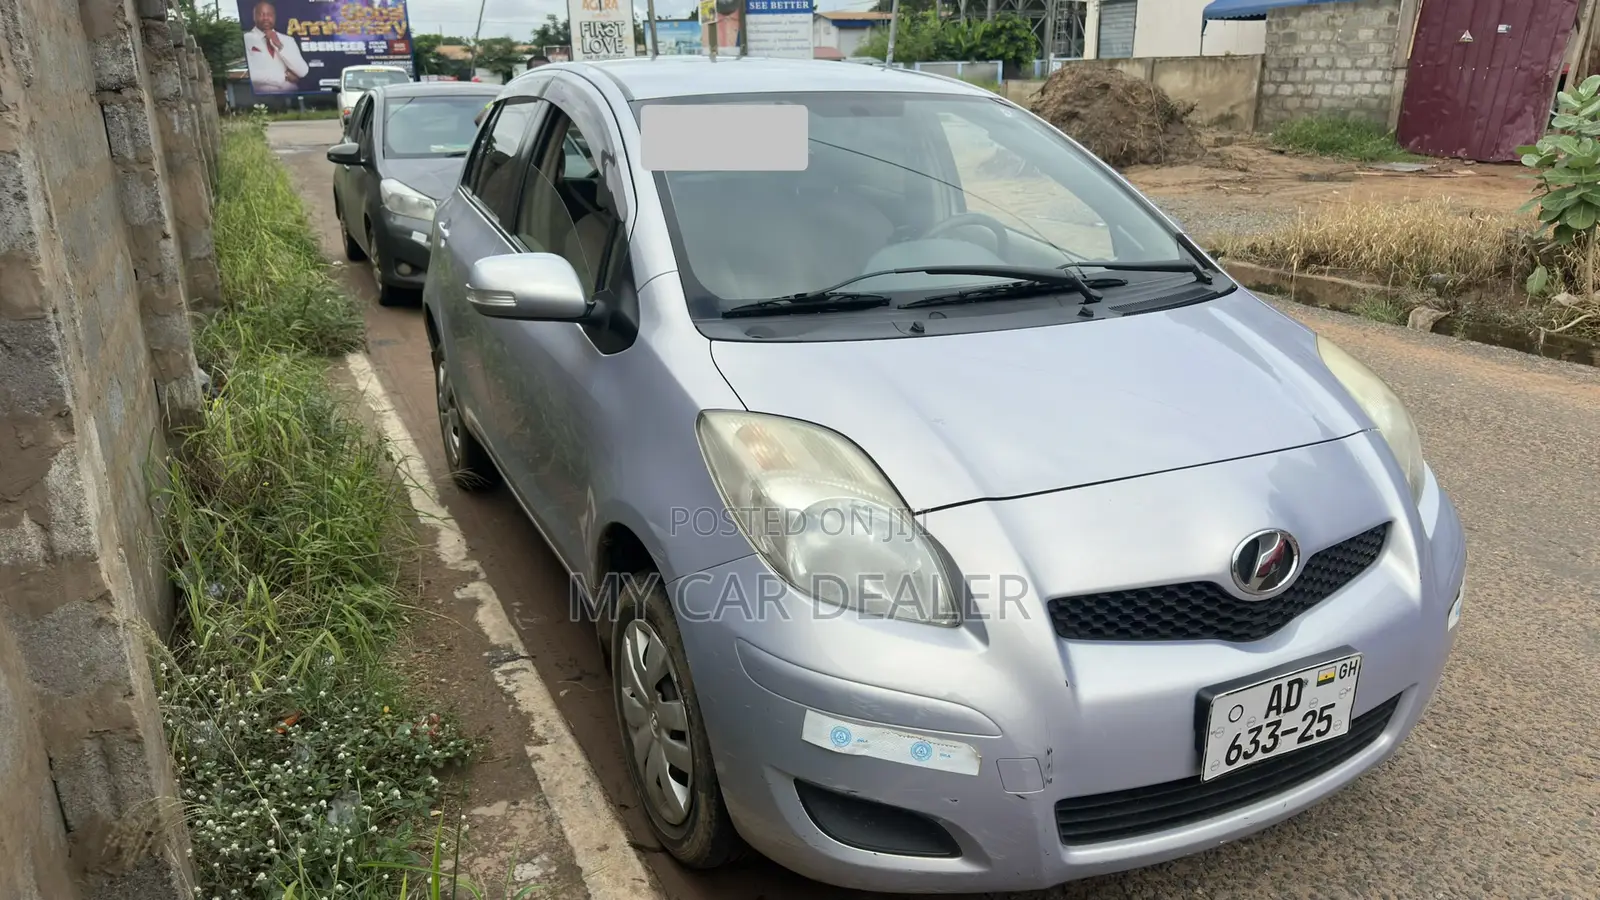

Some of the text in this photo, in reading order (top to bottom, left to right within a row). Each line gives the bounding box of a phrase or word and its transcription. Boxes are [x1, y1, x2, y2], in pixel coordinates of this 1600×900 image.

[749, 1, 809, 9] SEE BETTER
[287, 16, 407, 39] Anniversary
[580, 21, 625, 38] FIRST
[301, 41, 366, 52] EBENEZER
[581, 37, 625, 54] LOVE
[1338, 659, 1359, 680] GH
[1264, 677, 1303, 719] AD
[1225, 702, 1336, 767] 633-25
